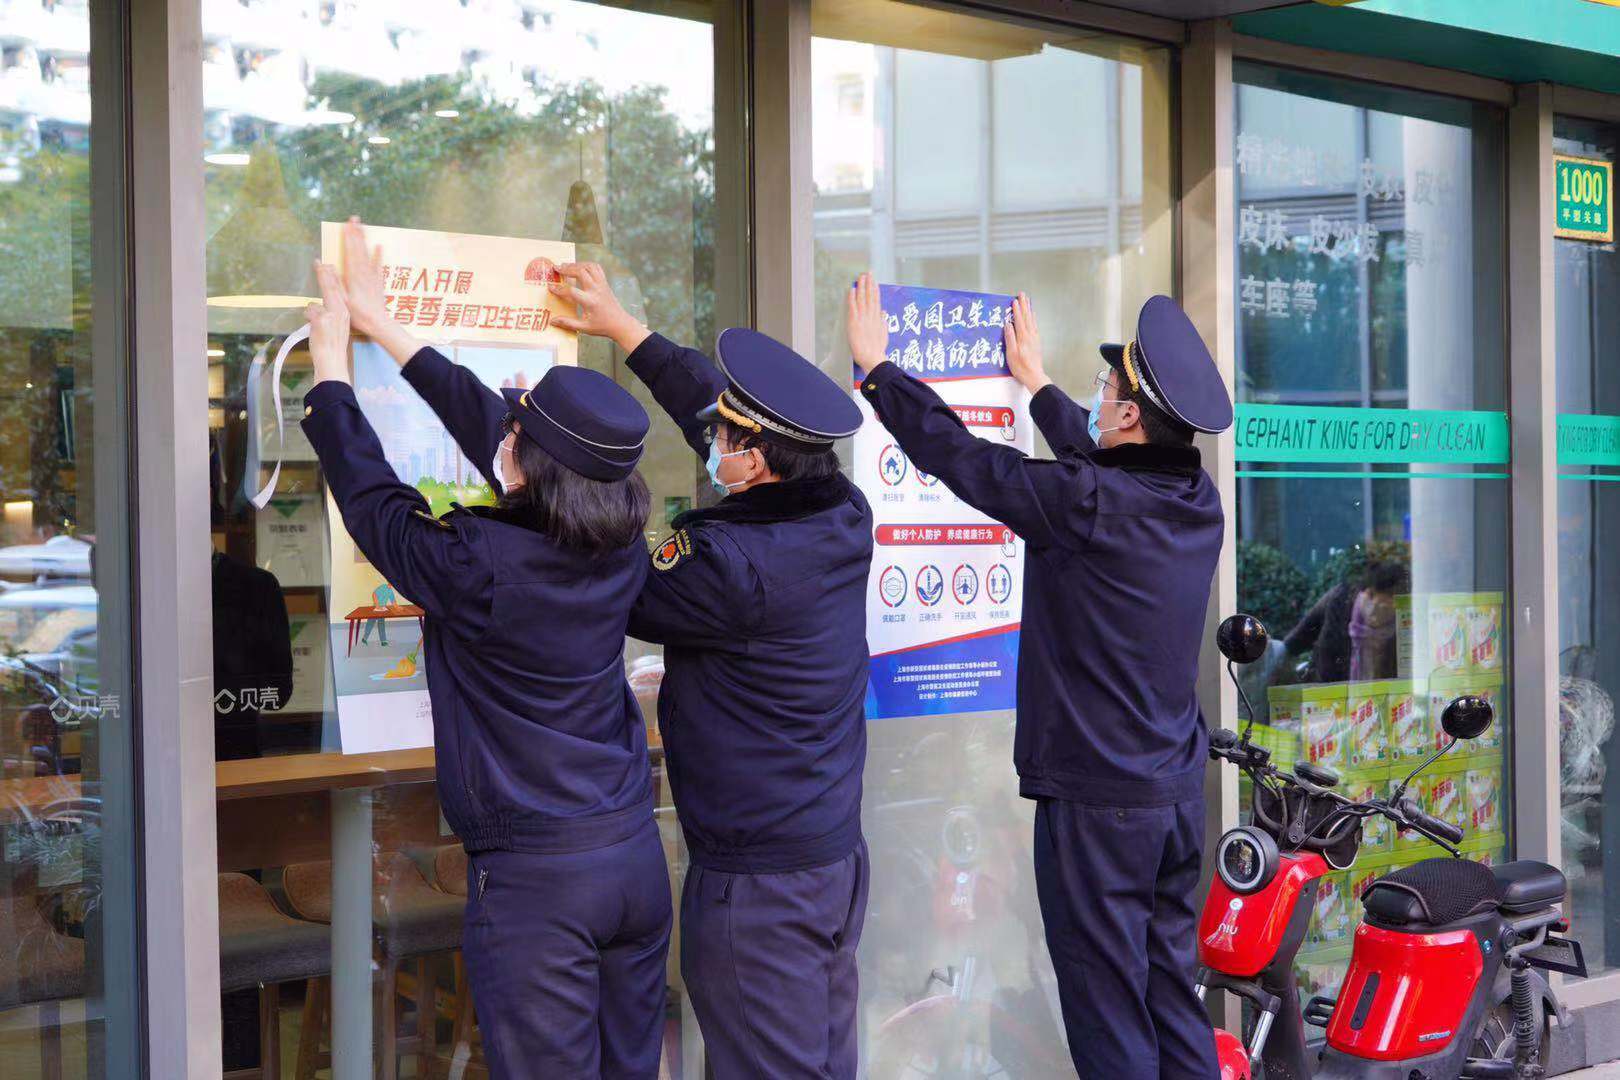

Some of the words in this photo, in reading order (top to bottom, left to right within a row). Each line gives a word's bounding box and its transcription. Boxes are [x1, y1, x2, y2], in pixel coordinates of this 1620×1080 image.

[1561, 167, 1603, 206] 1000
[1320, 419, 1359, 450] KING
[1362, 420, 1395, 450] FOR
[1437, 421, 1487, 451] CLEAN
[78, 694, 121, 719] 贝壳
[240, 686, 280, 712] 贝壳
